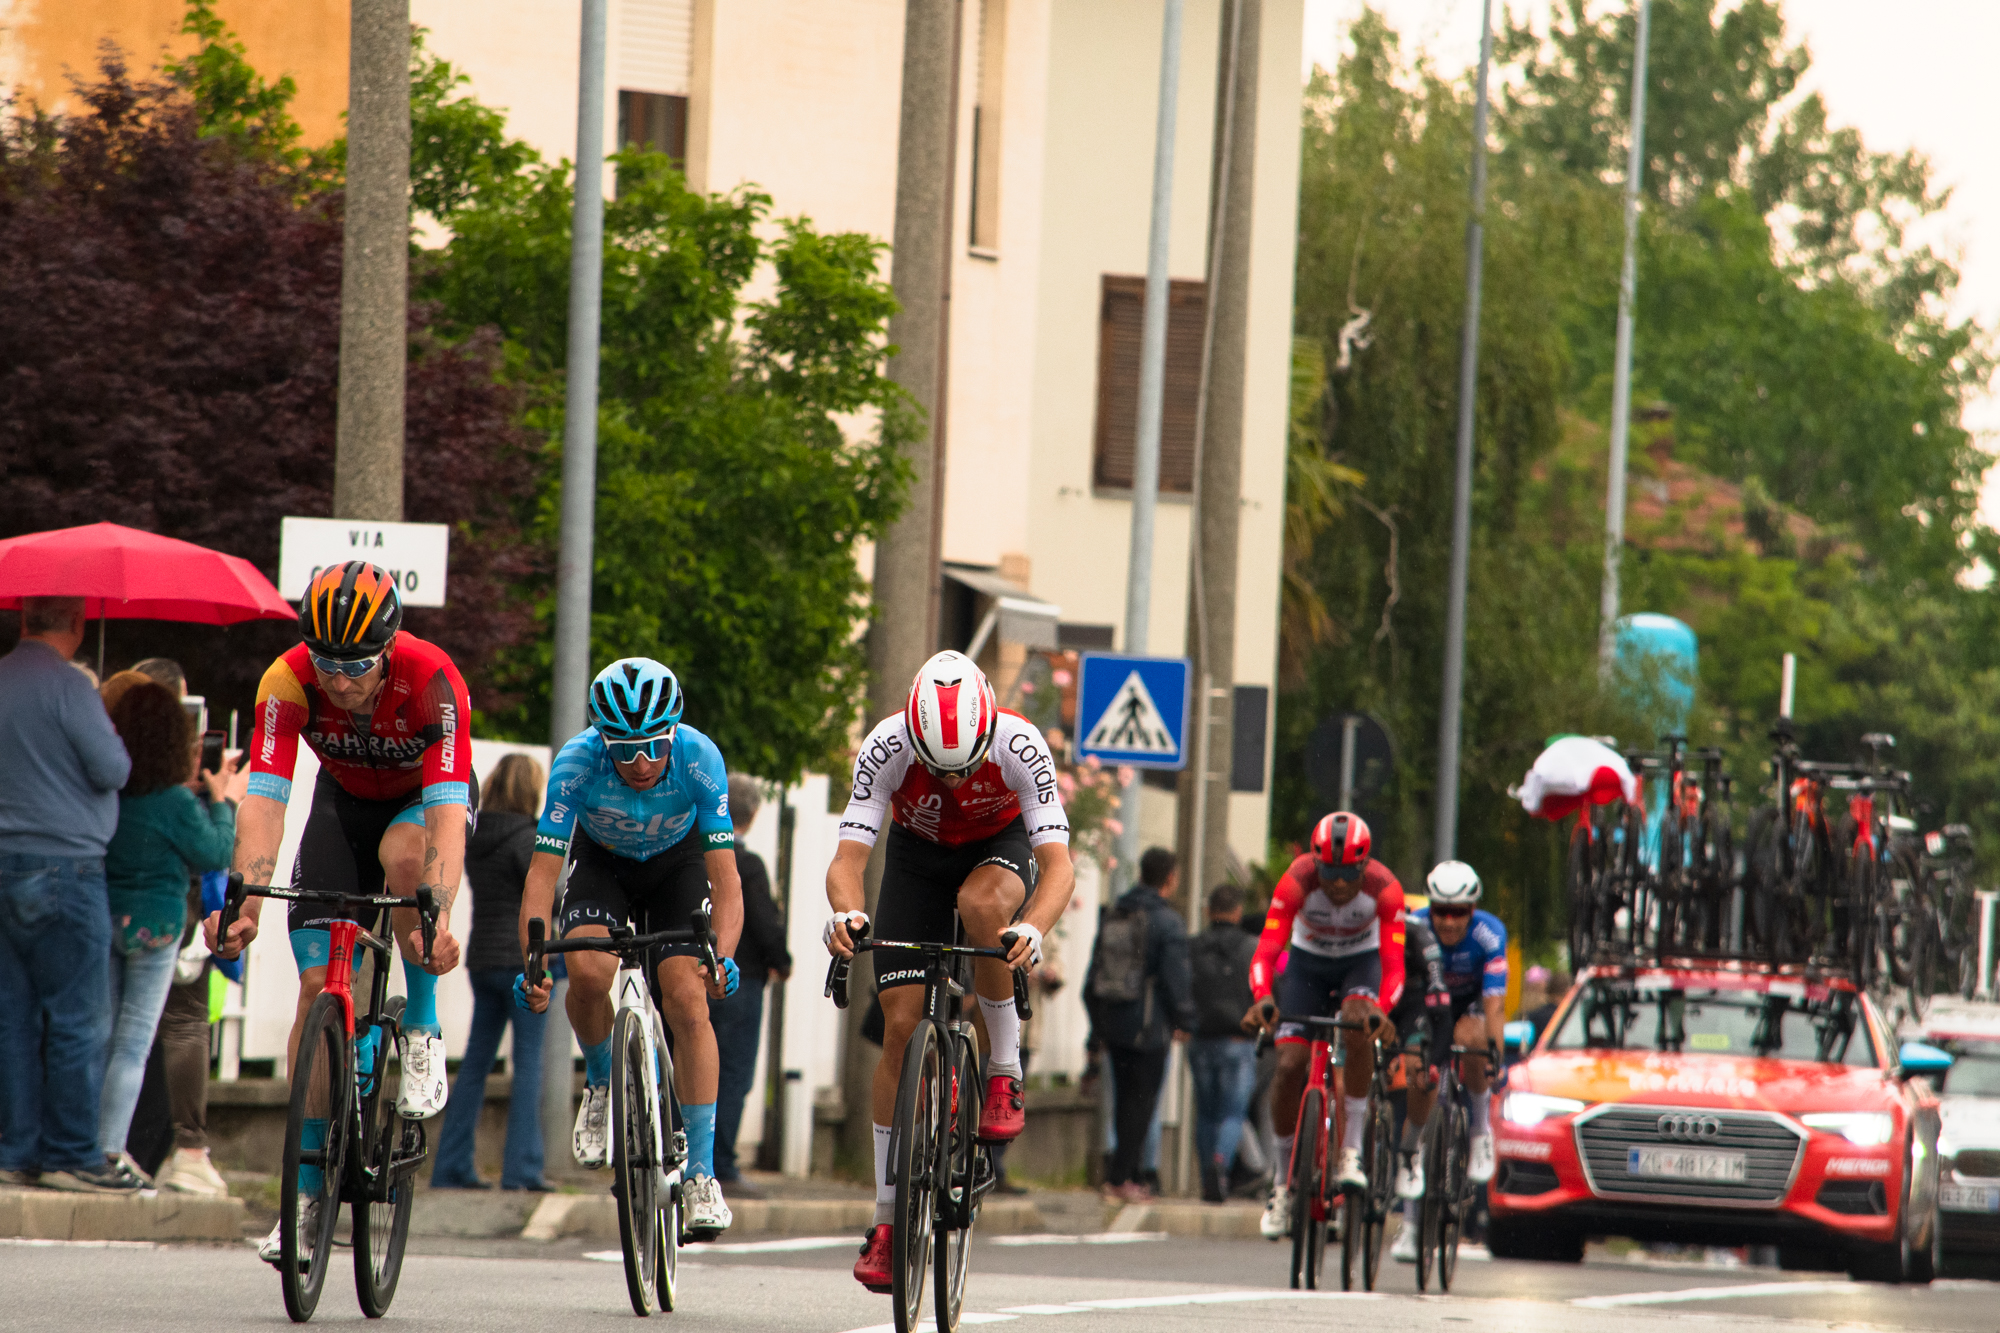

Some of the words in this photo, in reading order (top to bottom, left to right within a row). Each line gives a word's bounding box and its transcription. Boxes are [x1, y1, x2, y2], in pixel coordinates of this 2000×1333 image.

[349, 530, 384, 548] VIA
[919, 699, 929, 731] Cofidis
[969, 696, 978, 727] Cofidis
[260, 693, 281, 765] MERIDA
[310, 731, 426, 751] BAHRAIN
[439, 703, 456, 774] MERIDA
[693, 769, 719, 792] RETELIT
[853, 735, 903, 800] Cofidis
[1009, 733, 1056, 804] Cofidis
[902, 794, 942, 842] ofidis
[1029, 824, 1070, 837] LOO
[270, 888, 300, 898] Vision
[880, 969, 925, 984] CORIM
[929, 984, 938, 1016] LOOK
[997, 1001, 1015, 1009] RYSE
[402, 1110, 424, 1118] SIDI
